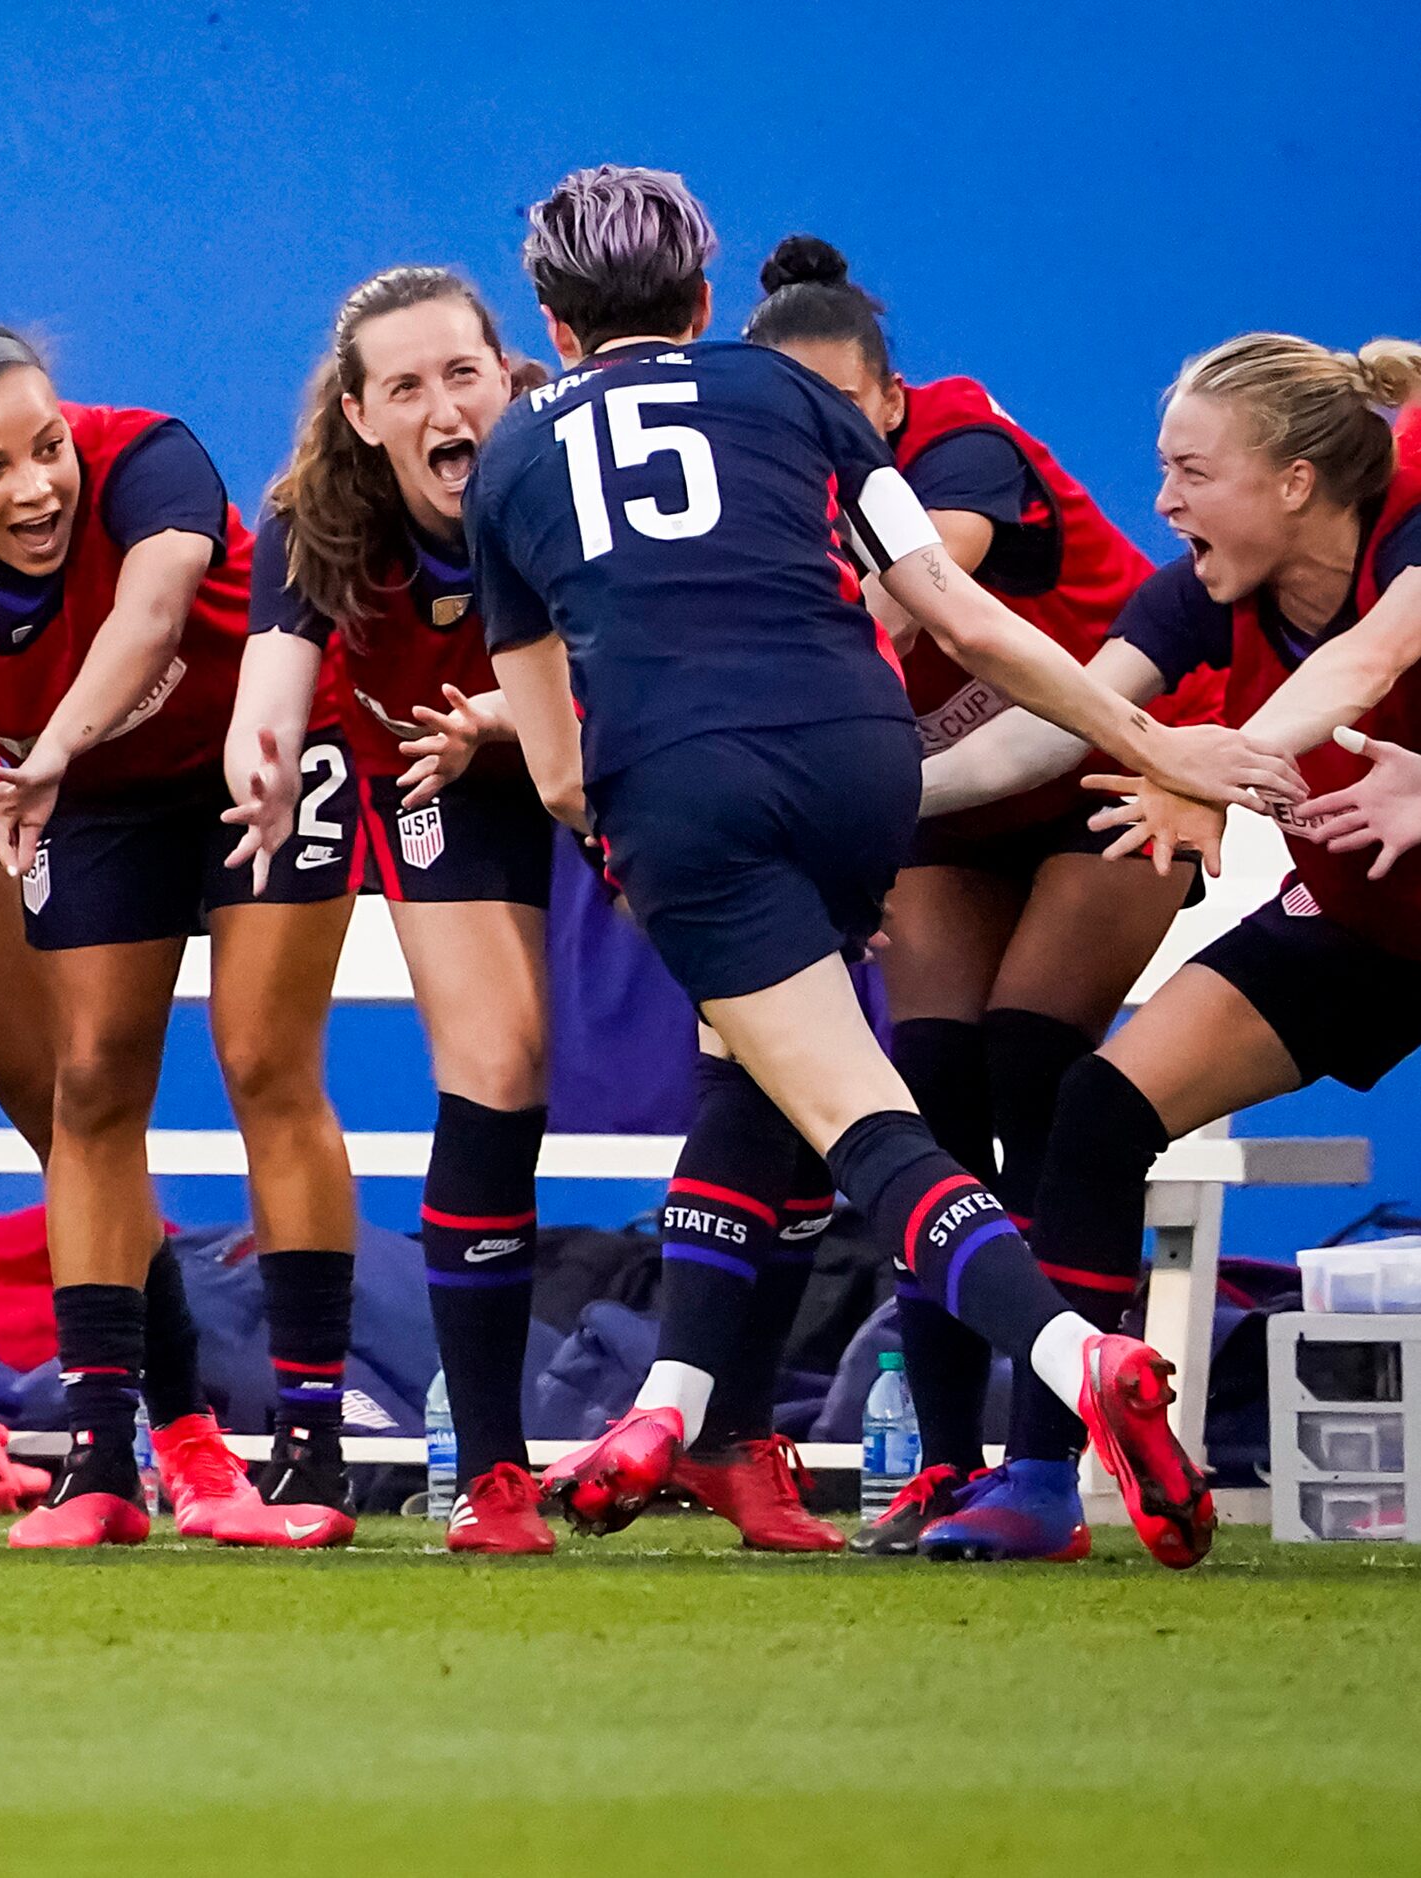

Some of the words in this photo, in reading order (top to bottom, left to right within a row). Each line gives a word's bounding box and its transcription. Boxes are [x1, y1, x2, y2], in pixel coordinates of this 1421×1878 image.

[553, 381, 722, 562] 15
[940, 689, 989, 738] CUP
[297, 743, 348, 840] 2
[401, 810, 438, 837] USA
[663, 1206, 748, 1245] STATES
[928, 1192, 1004, 1248] STATES
